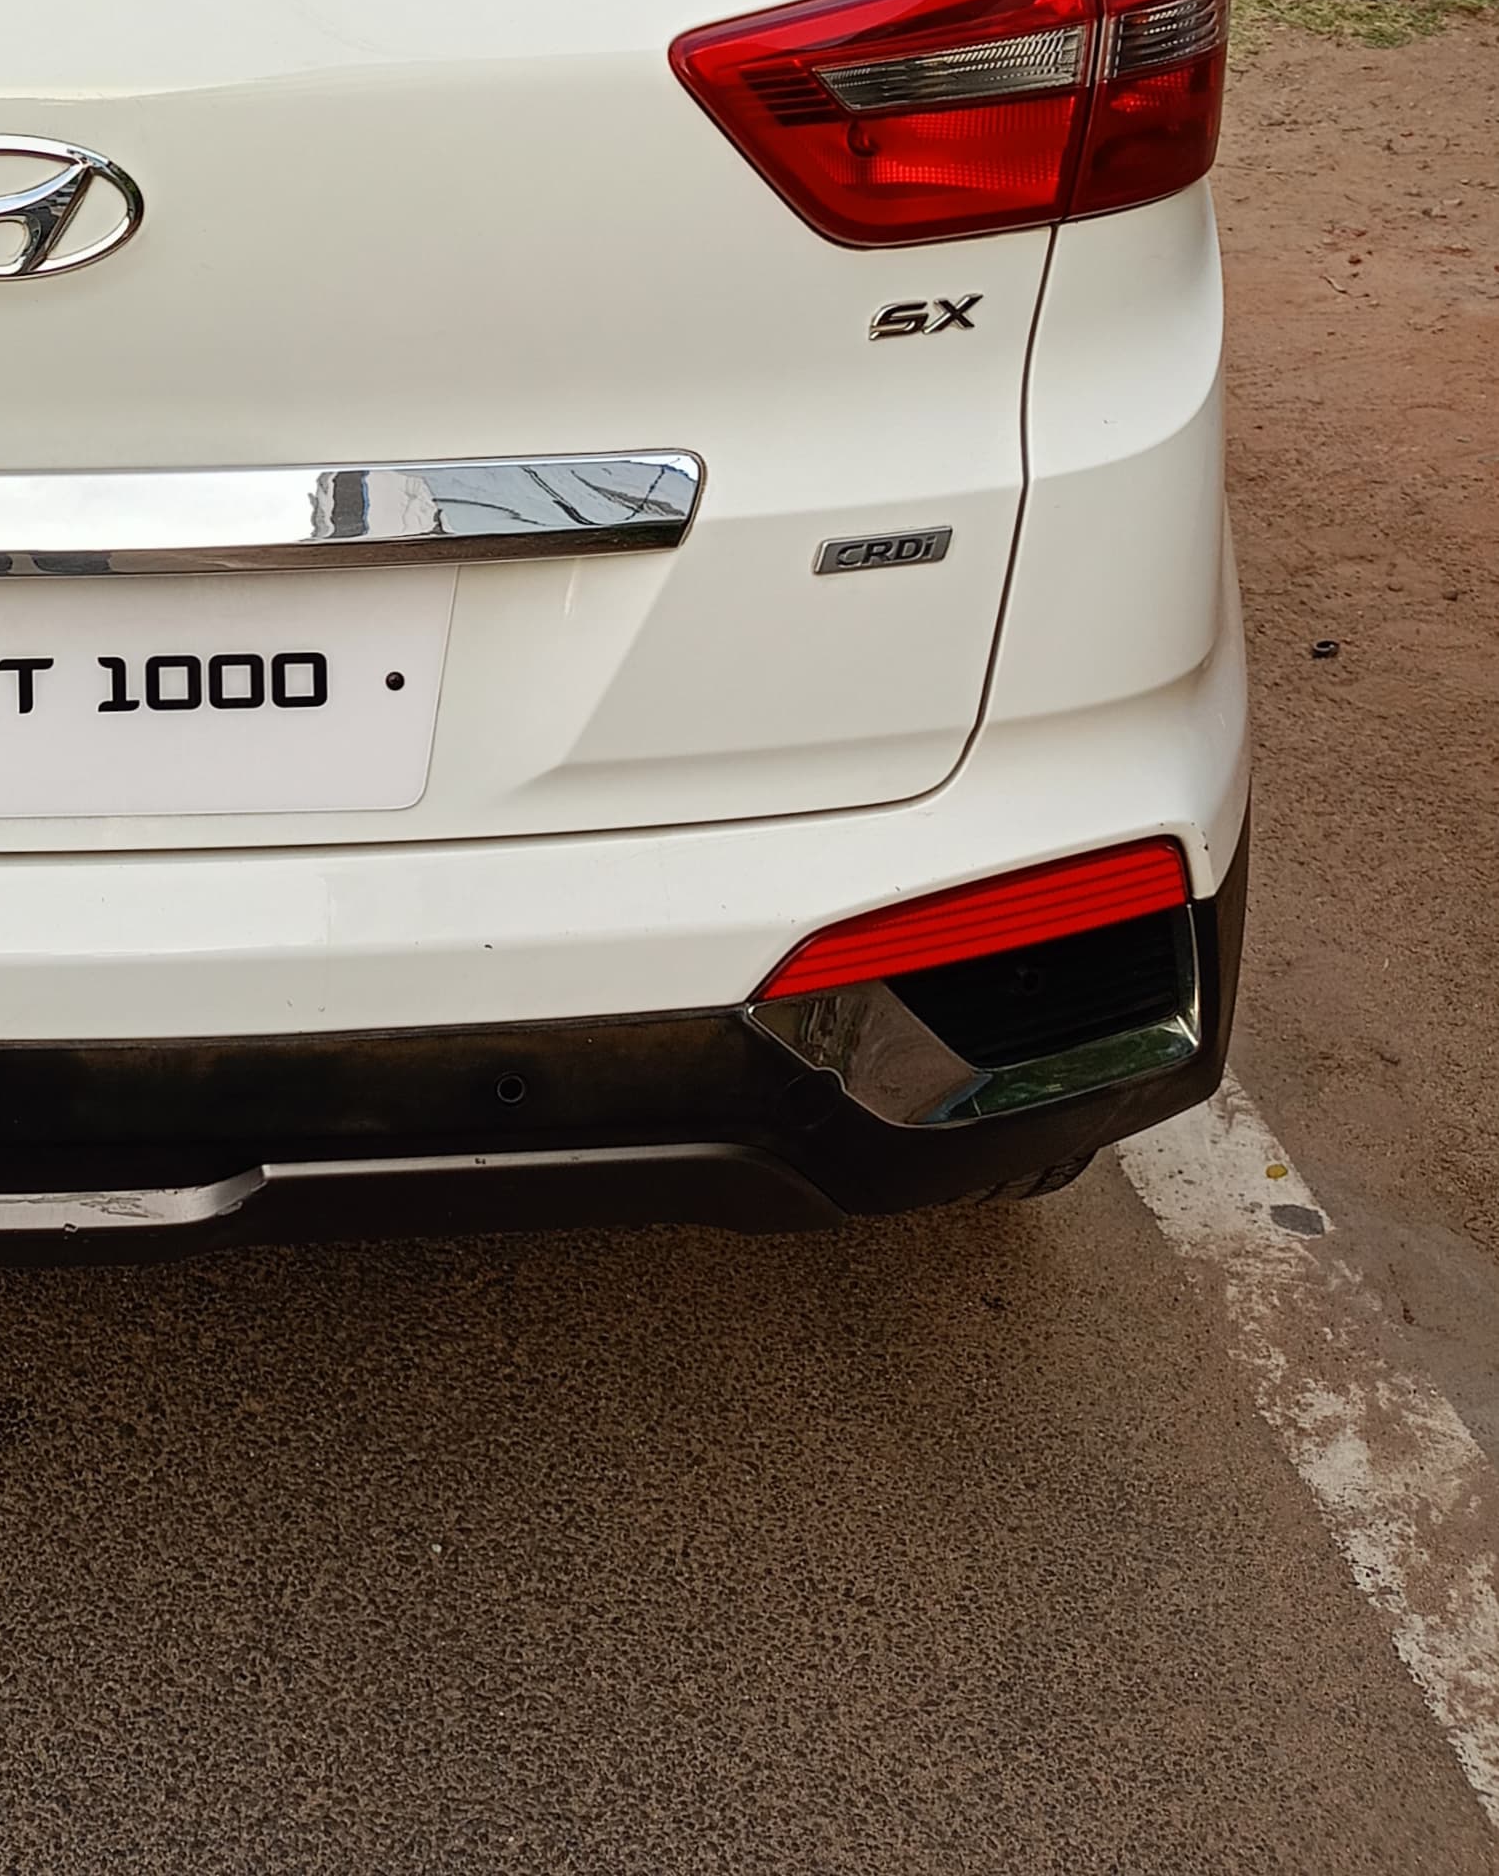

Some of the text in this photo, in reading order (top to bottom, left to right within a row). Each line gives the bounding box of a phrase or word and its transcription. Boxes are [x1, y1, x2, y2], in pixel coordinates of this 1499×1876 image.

[869, 292, 984, 341] SX
[837, 536, 936, 566] CRDi
[98, 653, 327, 712] 1000
